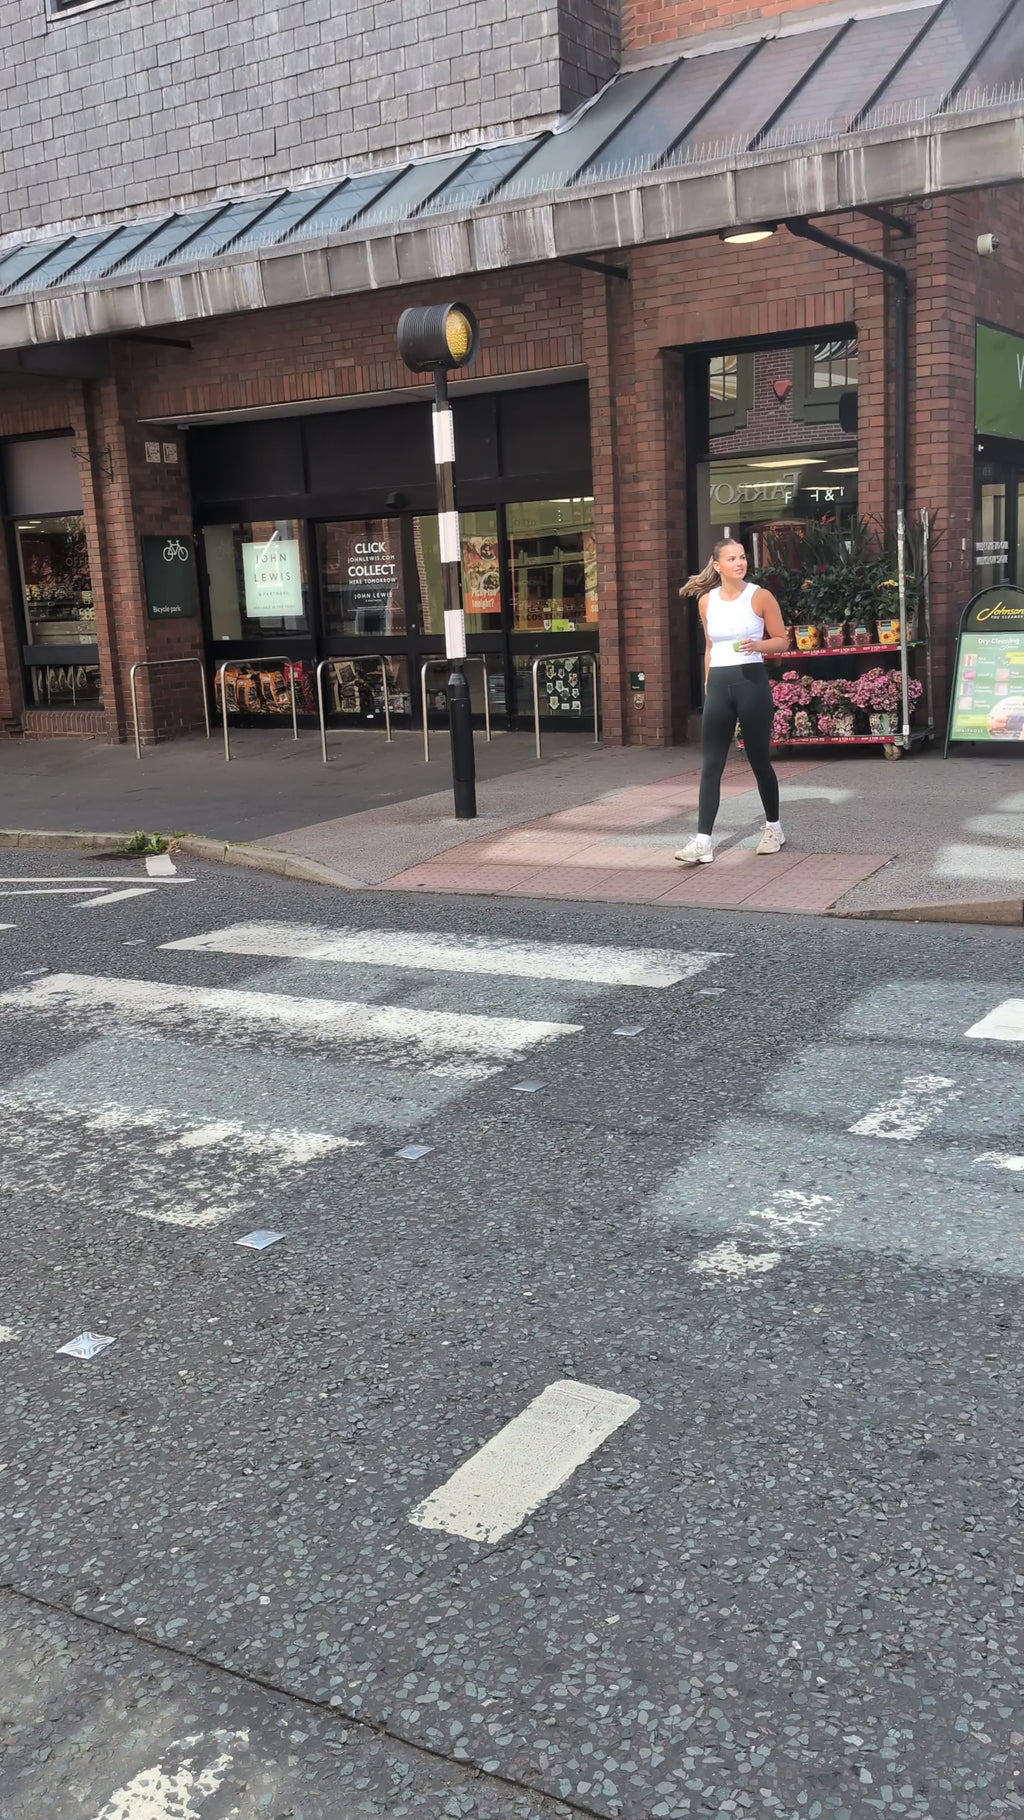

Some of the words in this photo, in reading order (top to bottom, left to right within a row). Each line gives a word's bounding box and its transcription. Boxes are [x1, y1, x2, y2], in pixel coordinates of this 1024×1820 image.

[354, 542, 387, 554] CLICK
[255, 553, 287, 564] JOHN
[347, 555, 395, 564] JOHNLEWIS.COM
[347, 564, 396, 577] COLLECT
[254, 571, 291, 582] LEWIS
[372, 591, 393, 599] LEWIS
[152, 605, 170, 614] Bicycle
[170, 605, 181, 614] park
[991, 637, 1020, 645] Cleaning
